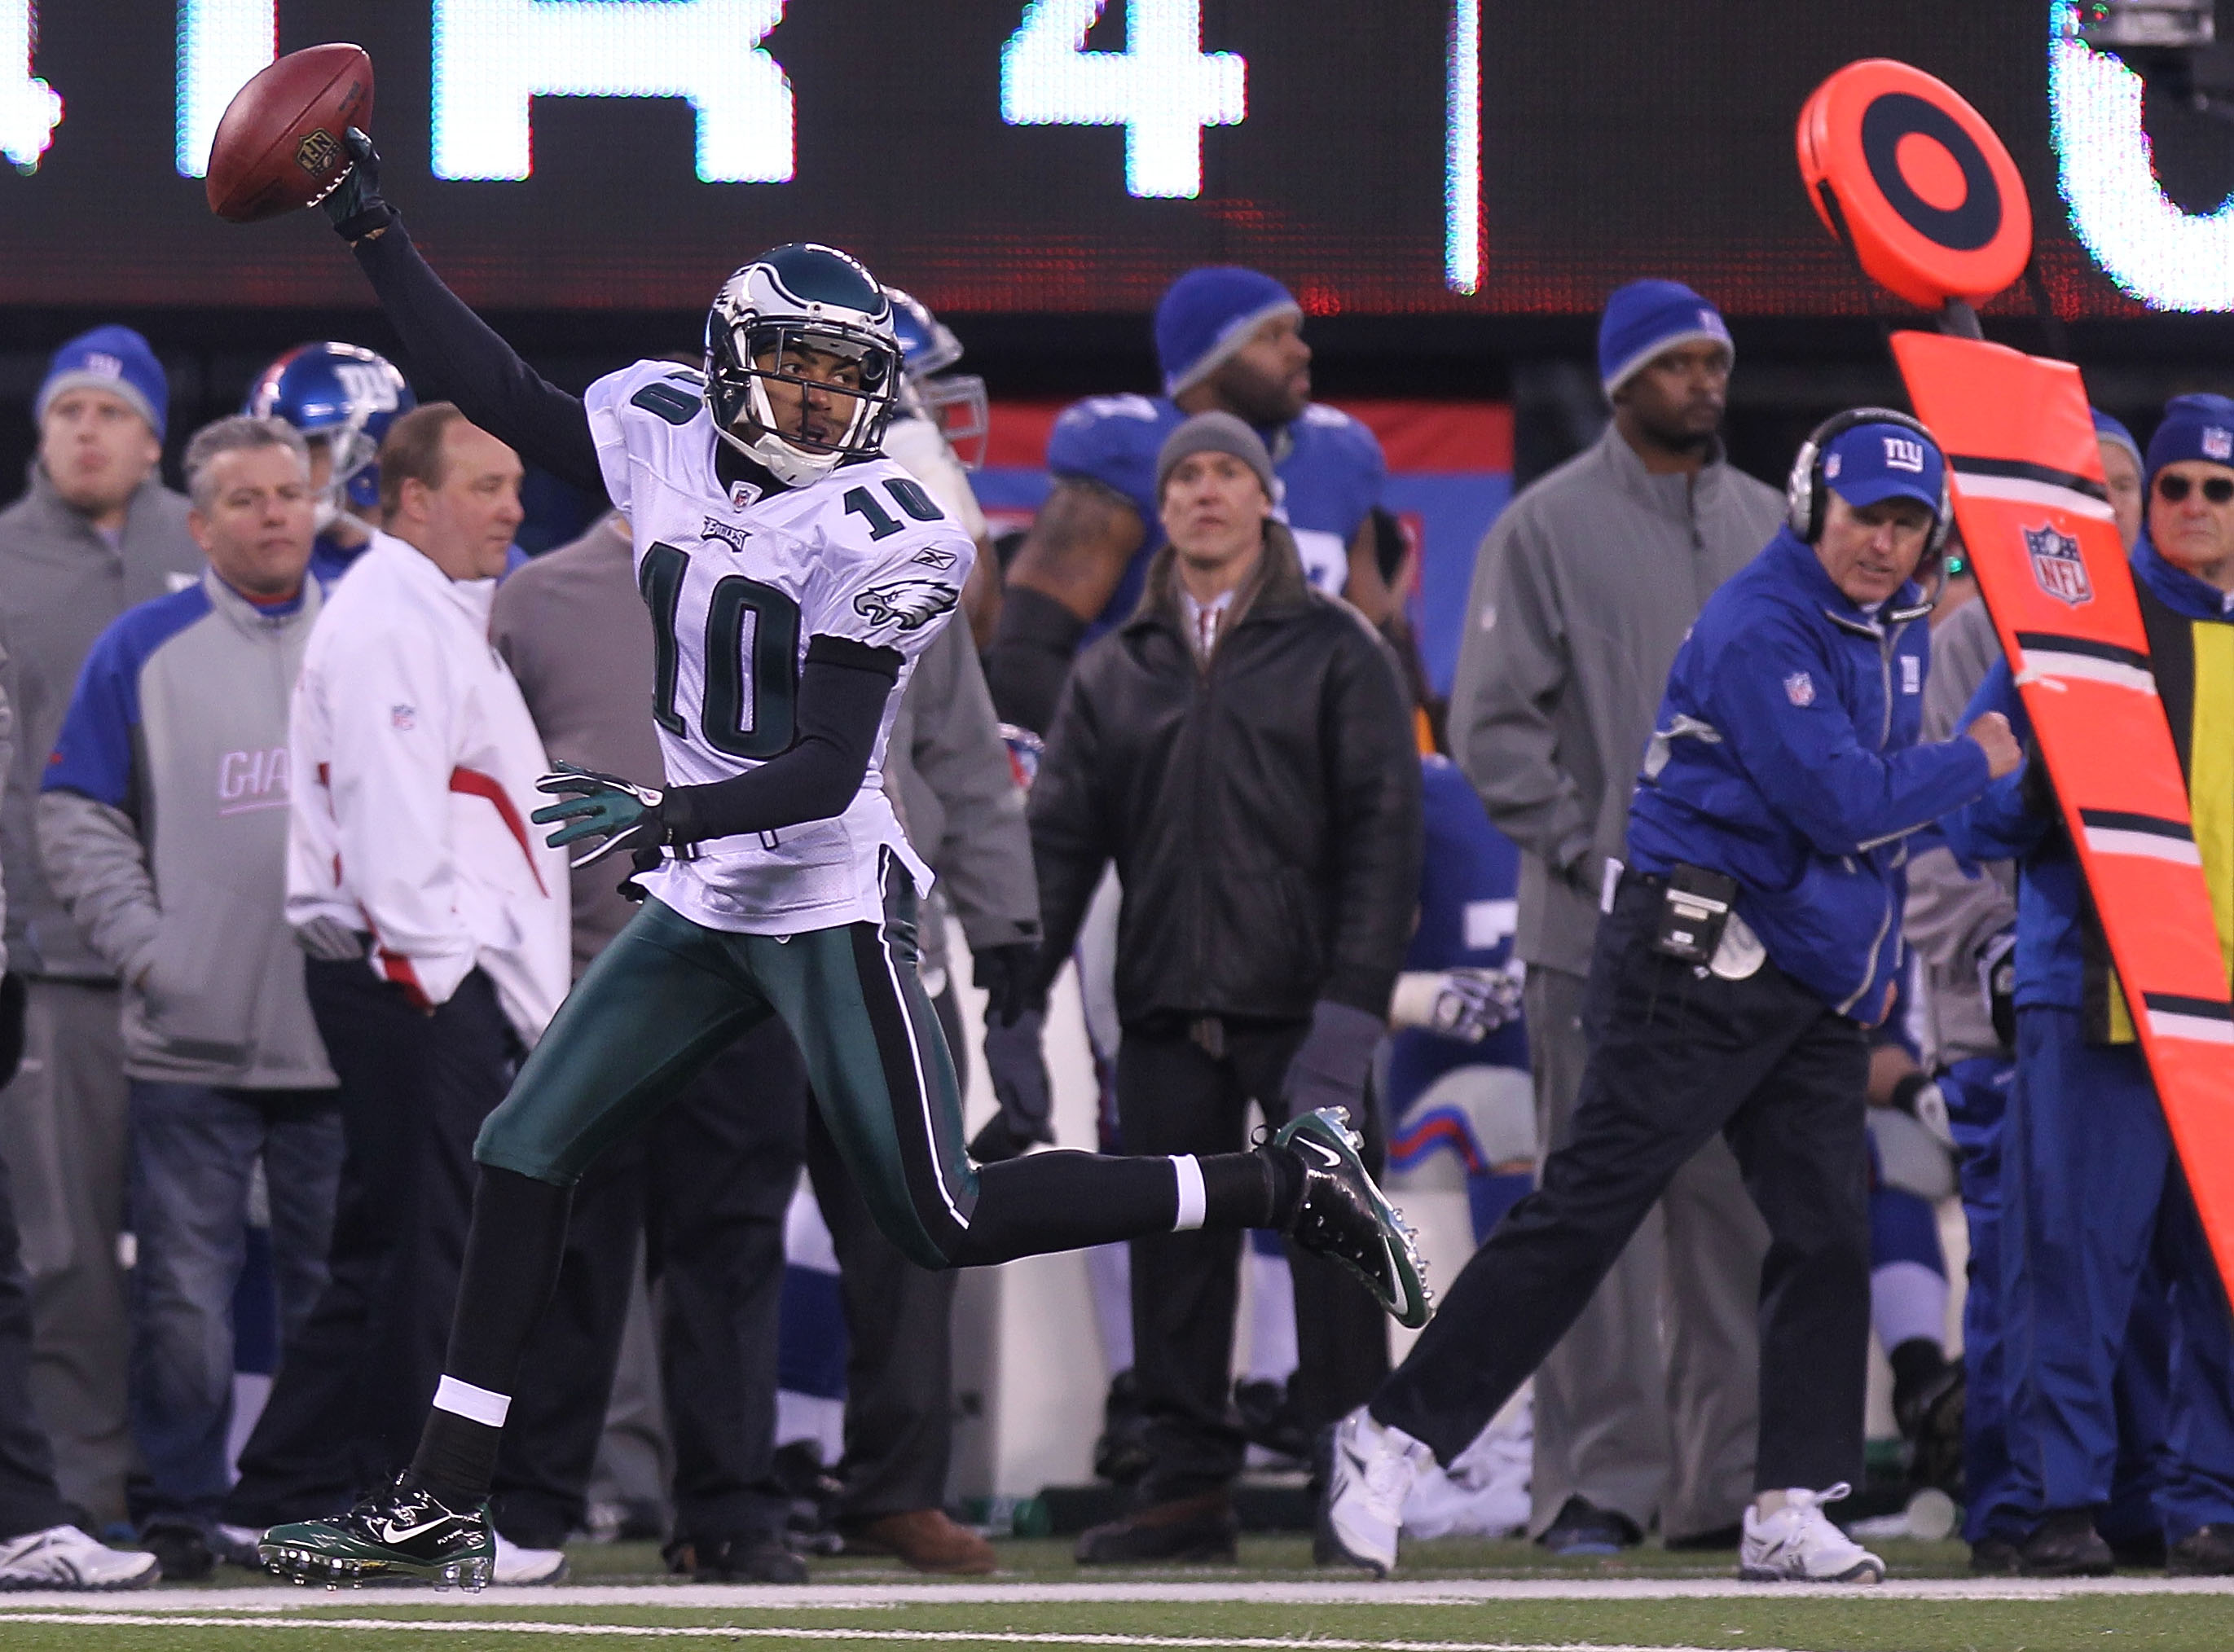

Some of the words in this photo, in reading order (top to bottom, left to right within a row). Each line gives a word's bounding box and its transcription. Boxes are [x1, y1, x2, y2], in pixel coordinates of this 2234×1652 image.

[701, 517, 748, 550] EAGLES
[843, 478, 945, 542] 10
[2036, 556, 2088, 597] NFL
[639, 540, 802, 758] 10
[220, 749, 291, 798] GIA
